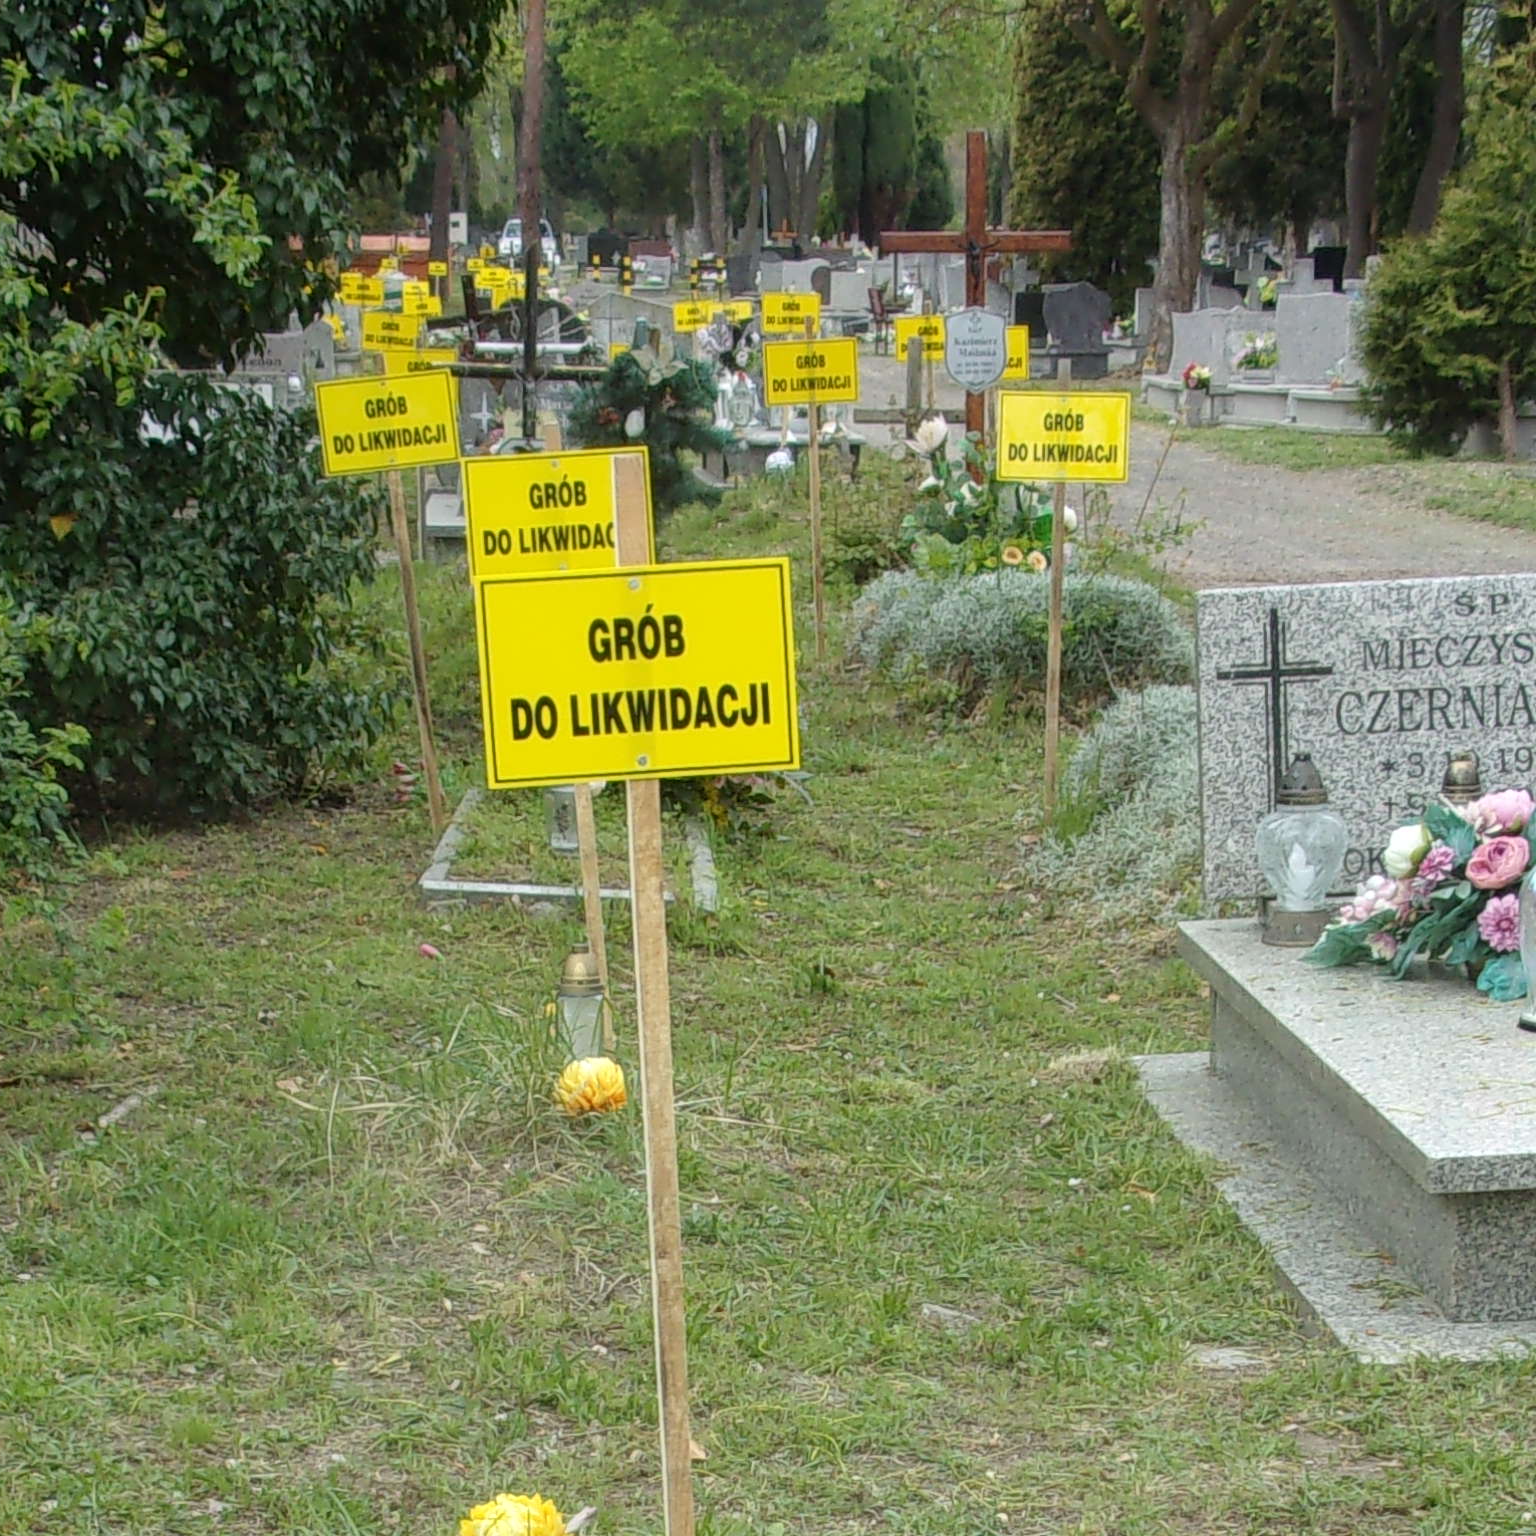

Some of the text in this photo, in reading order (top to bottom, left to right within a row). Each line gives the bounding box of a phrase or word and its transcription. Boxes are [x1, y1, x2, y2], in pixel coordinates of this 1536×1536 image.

[796, 352, 825, 369] GRÓB
[773, 375, 851, 392] DO LIKWIDACJI
[365, 391, 408, 418] GRÓB
[1044, 408, 1084, 432] GRÓB
[333, 423, 447, 454] DO LIKWIDACJI
[1008, 443, 1118, 463] DO LIKWIDACJI
[529, 474, 587, 509] GRÓB
[483, 529, 512, 556] DO
[588, 604, 685, 663] GRÓB
[511, 682, 771, 741] DO LIKWIDACJI
